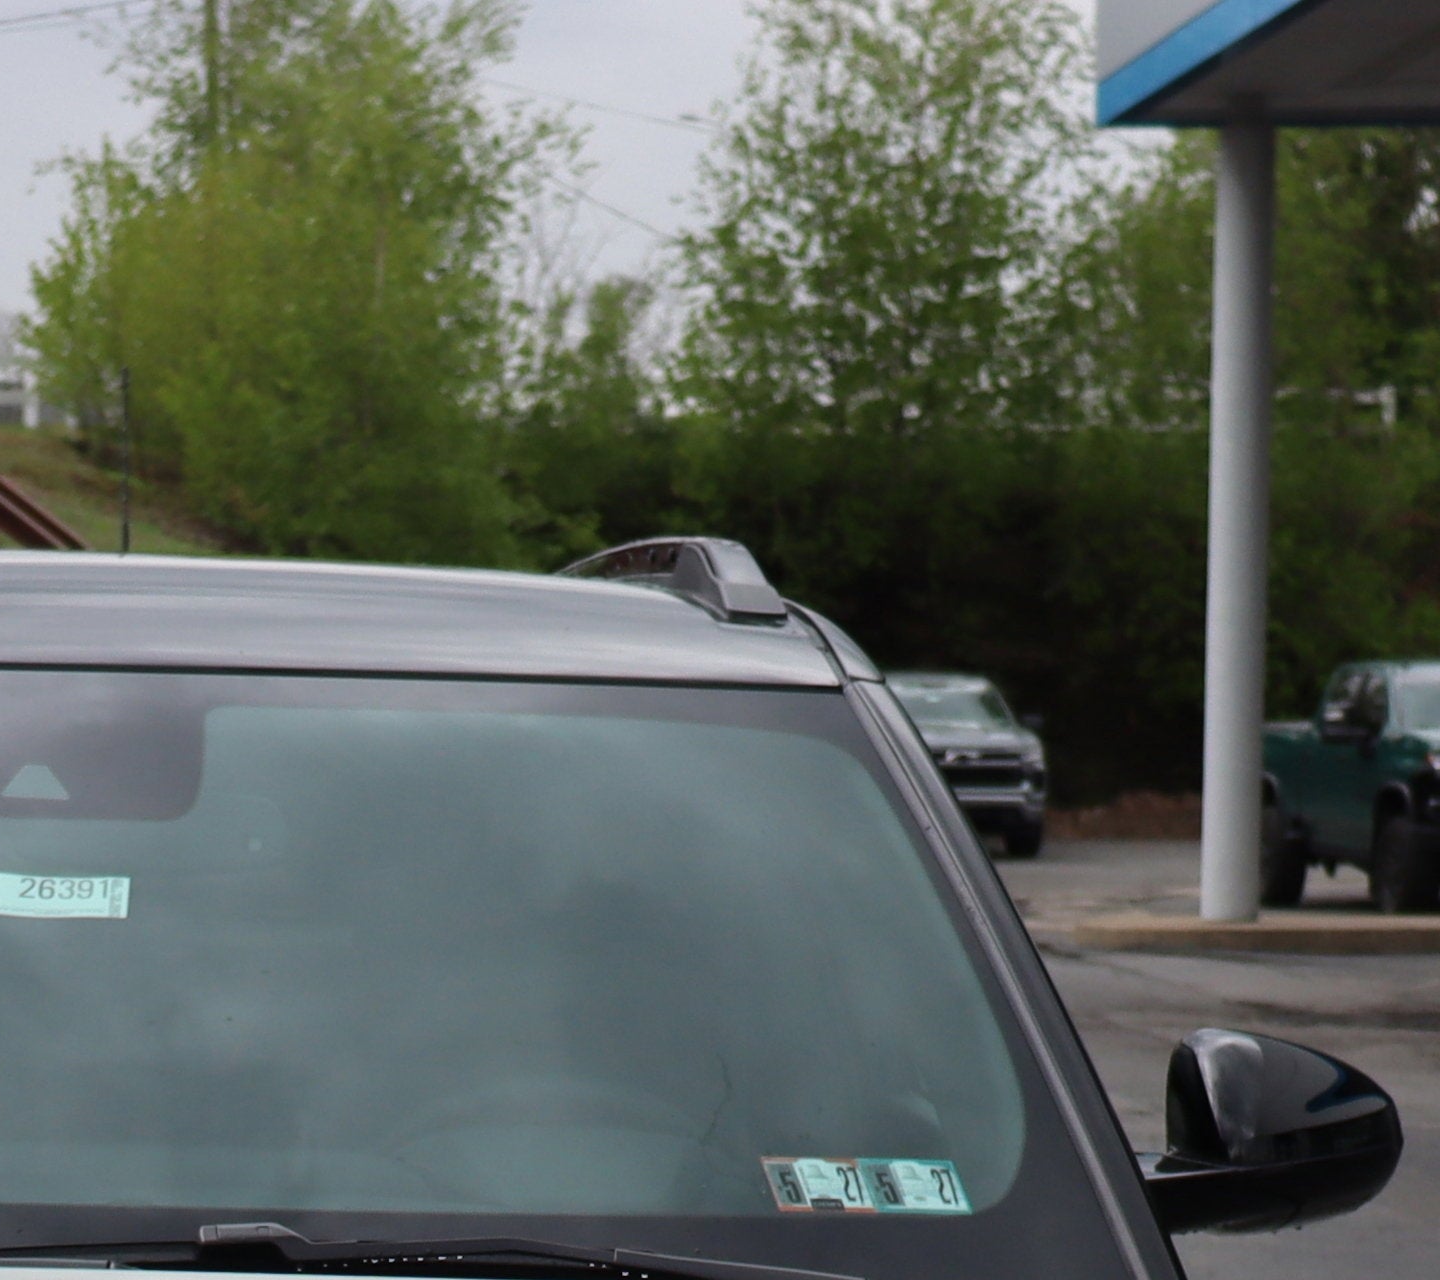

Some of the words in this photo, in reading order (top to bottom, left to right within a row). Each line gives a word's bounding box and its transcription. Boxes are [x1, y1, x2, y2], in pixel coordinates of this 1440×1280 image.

[19, 877, 109, 900] 26391
[779, 1170, 801, 1204] 5
[836, 1166, 864, 1204] 27
[876, 1172, 900, 1205] 5
[930, 1168, 959, 1205] 27
